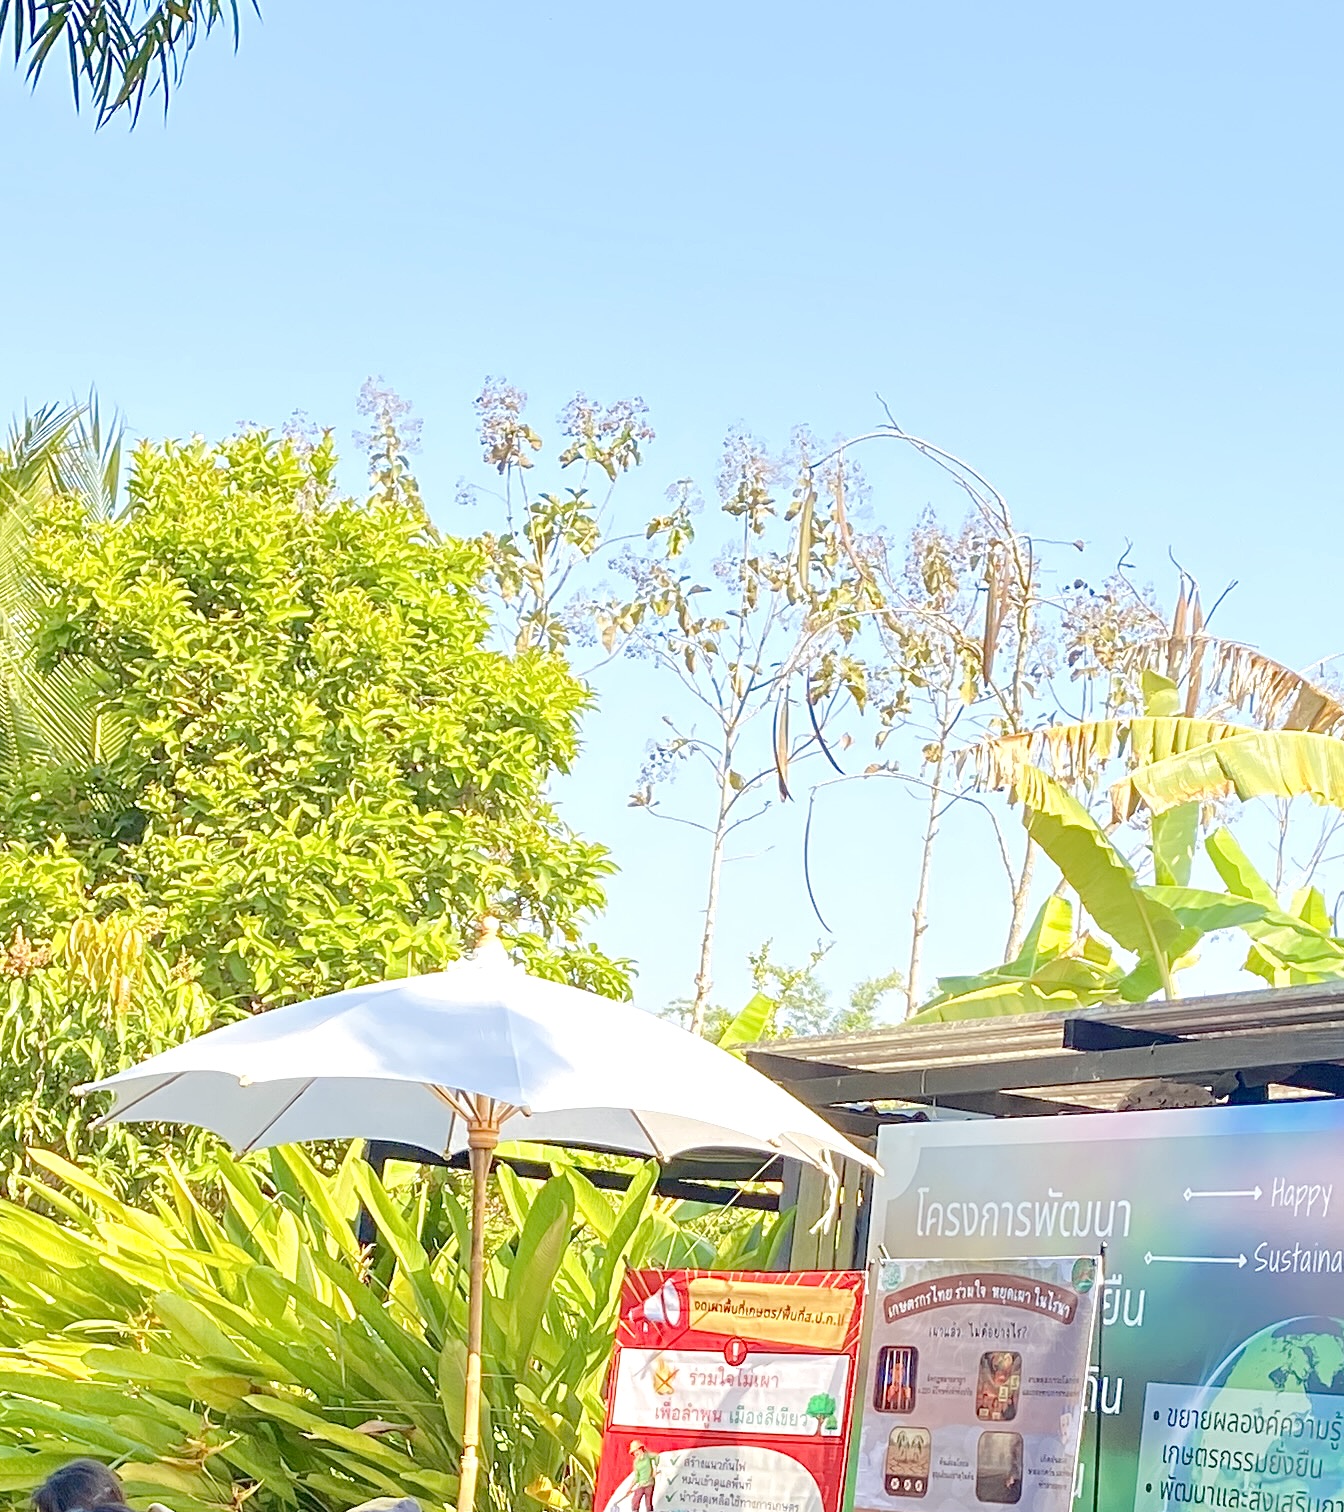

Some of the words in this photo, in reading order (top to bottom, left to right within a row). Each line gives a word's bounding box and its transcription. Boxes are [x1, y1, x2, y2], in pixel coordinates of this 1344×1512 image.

[915, 1187, 1132, 1238] โครงการพัฒนา
[1271, 1177, 1333, 1217] Happy
[1167, 1407, 1344, 1450] ขยายผลองค์ความรู้
[1162, 1440, 1323, 1479] เกษตรกรรมยั่งยืน
